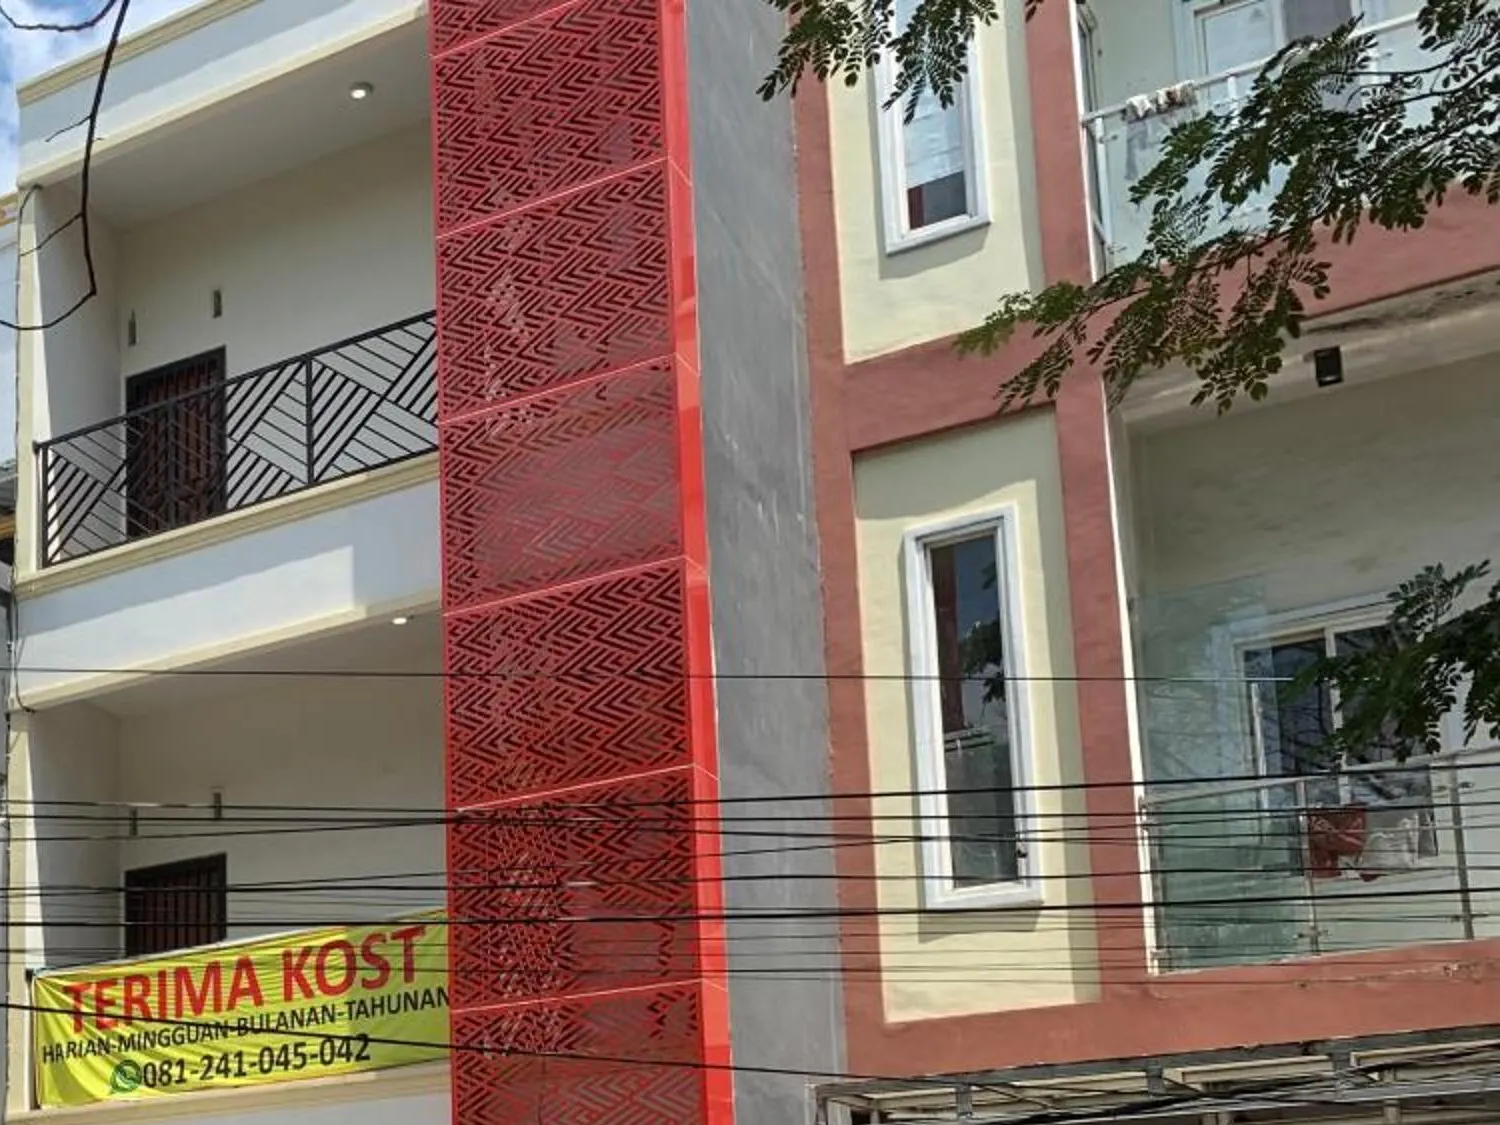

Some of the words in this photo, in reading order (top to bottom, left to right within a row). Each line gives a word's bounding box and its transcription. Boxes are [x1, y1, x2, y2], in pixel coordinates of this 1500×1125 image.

[63, 954, 264, 1034] TERIMA
[282, 925, 426, 1001] KOST
[142, 1033, 371, 1088] 081-241-045-042
